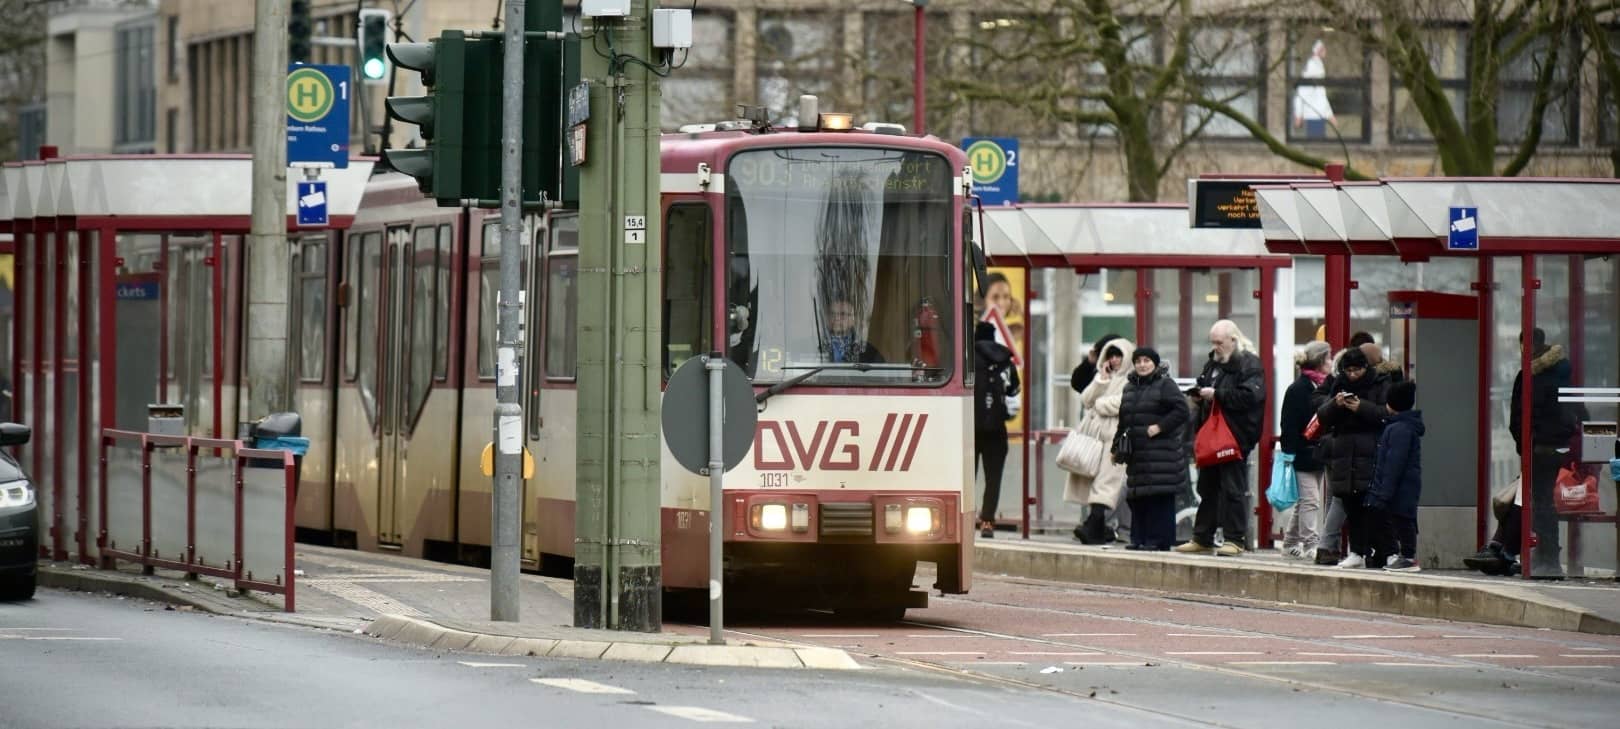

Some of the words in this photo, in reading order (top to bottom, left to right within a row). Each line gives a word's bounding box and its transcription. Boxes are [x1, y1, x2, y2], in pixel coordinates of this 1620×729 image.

[297, 83, 317, 107] H
[339, 81, 347, 100] 1
[977, 153, 993, 172] H
[1006, 150, 1016, 166] 2
[627, 218, 642, 227] 15,4
[632, 232, 637, 240] 1
[754, 420, 859, 471] DVG
[760, 473, 788, 487] 1031
